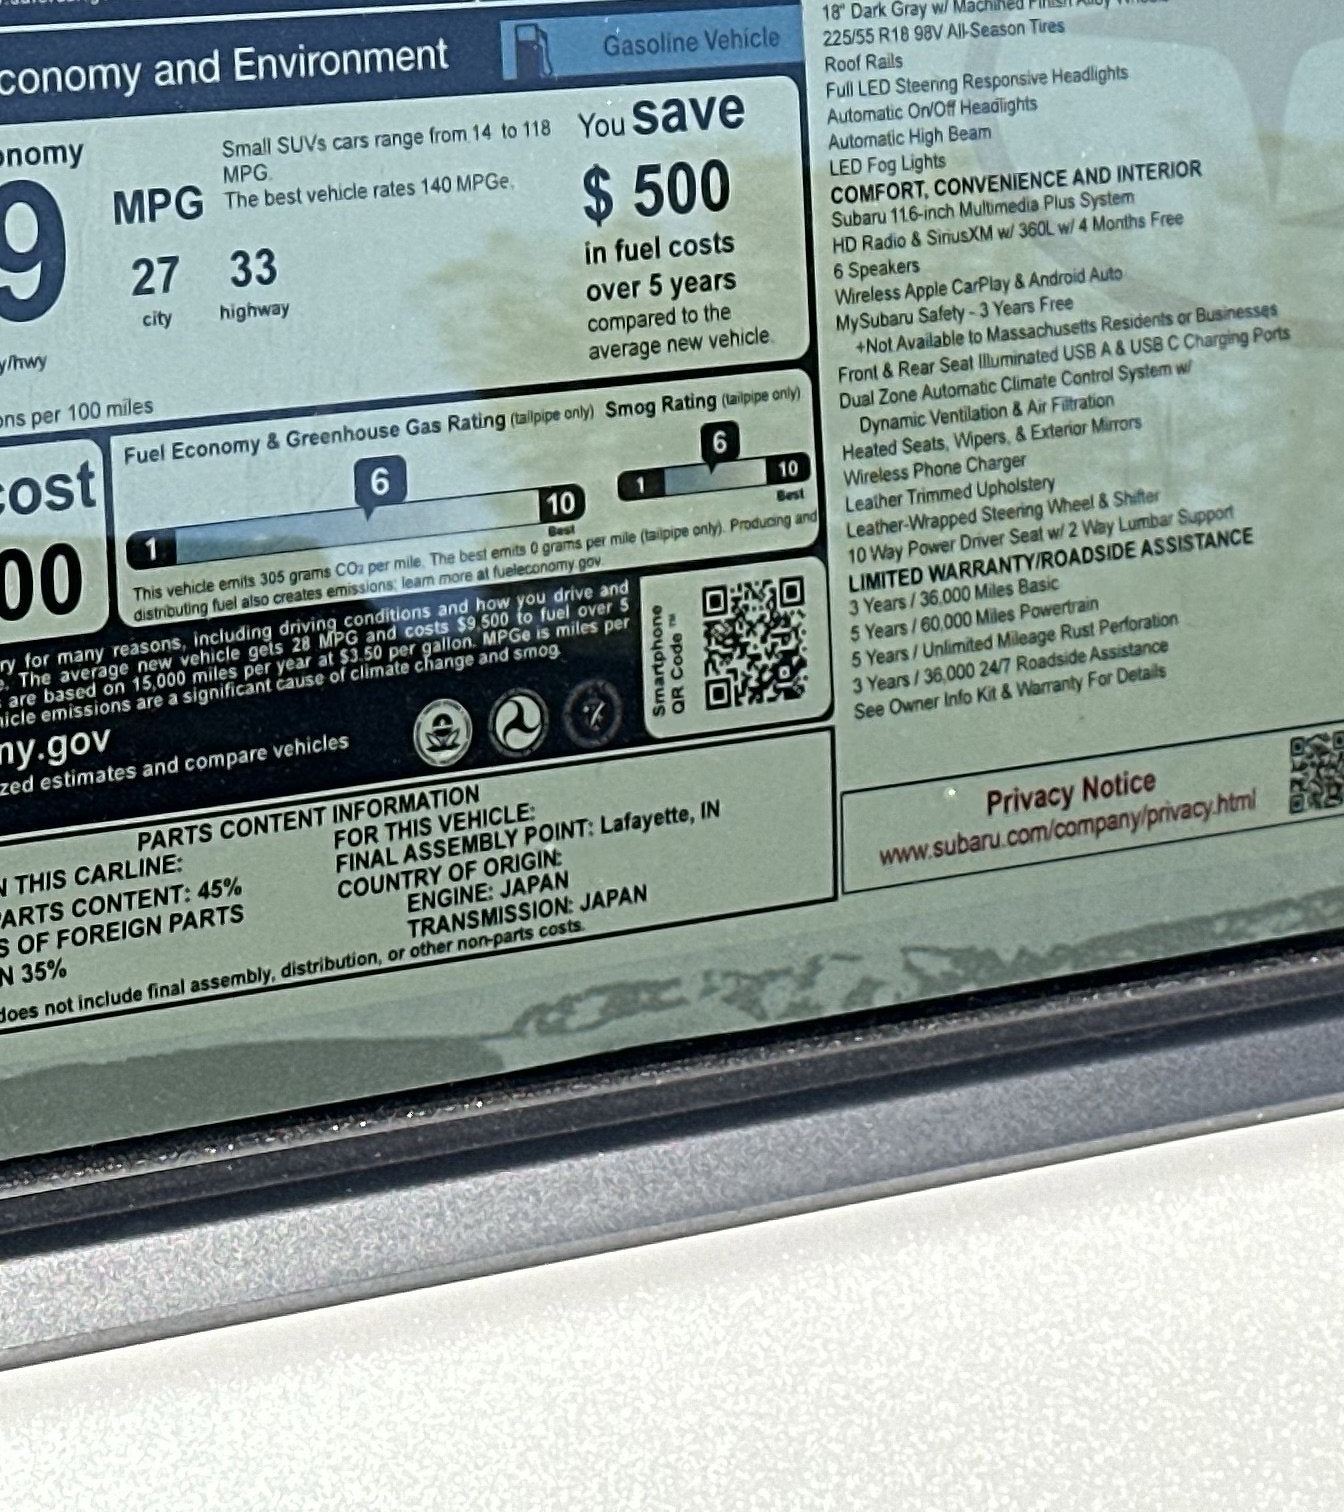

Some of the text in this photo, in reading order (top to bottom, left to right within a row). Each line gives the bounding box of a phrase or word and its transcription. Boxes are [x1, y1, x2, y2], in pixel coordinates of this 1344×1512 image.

[154, 48, 221, 87] and
[233, 37, 450, 82] Environment
[602, 25, 781, 58] Gasoline Vehicle
[577, 94, 745, 139] You save
[113, 184, 204, 226] MPG
[583, 158, 730, 228] $ 500
[230, 247, 278, 288] 33
[584, 231, 735, 266] in fuel costs
[131, 255, 180, 297] 27
[586, 271, 737, 303] over 5 years
[142, 310, 173, 330] city
[219, 301, 290, 324] highway
[31, 409, 62, 430] per
[68, 400, 101, 422] 100
[106, 397, 154, 418] miles
[605, 392, 717, 419] Smog Rating
[124, 411, 507, 466] Fuel Economy & Greenhouse Gas Rating
[712, 429, 728, 454] 6
[370, 466, 390, 496] 6
[636, 476, 645, 494] 1
[778, 459, 799, 478] 10
[546, 491, 576, 516] 10
[145, 536, 157, 561] 1
[848, 526, 1254, 594] LIMITED WARRANTY/ROADSIDE ASSISTANCE
[653, 604, 666, 717] Smartphone
[671, 687, 685, 715] QR
[40, 765, 138, 791] estimates
[142, 755, 179, 778] and
[184, 747, 268, 772] compare
[272, 733, 350, 759] vehicles
[987, 772, 1157, 817] Privacy Notice
[137, 783, 481, 853] PARTS CONTENT INFORMATION
[336, 798, 720, 874] FINAL ASSEMBLY POINT: Lafayette, IN
[13, 869, 67, 896] THIS
[74, 853, 184, 886] CARLINE:
[407, 869, 569, 914] ENGINE: JAPAN
